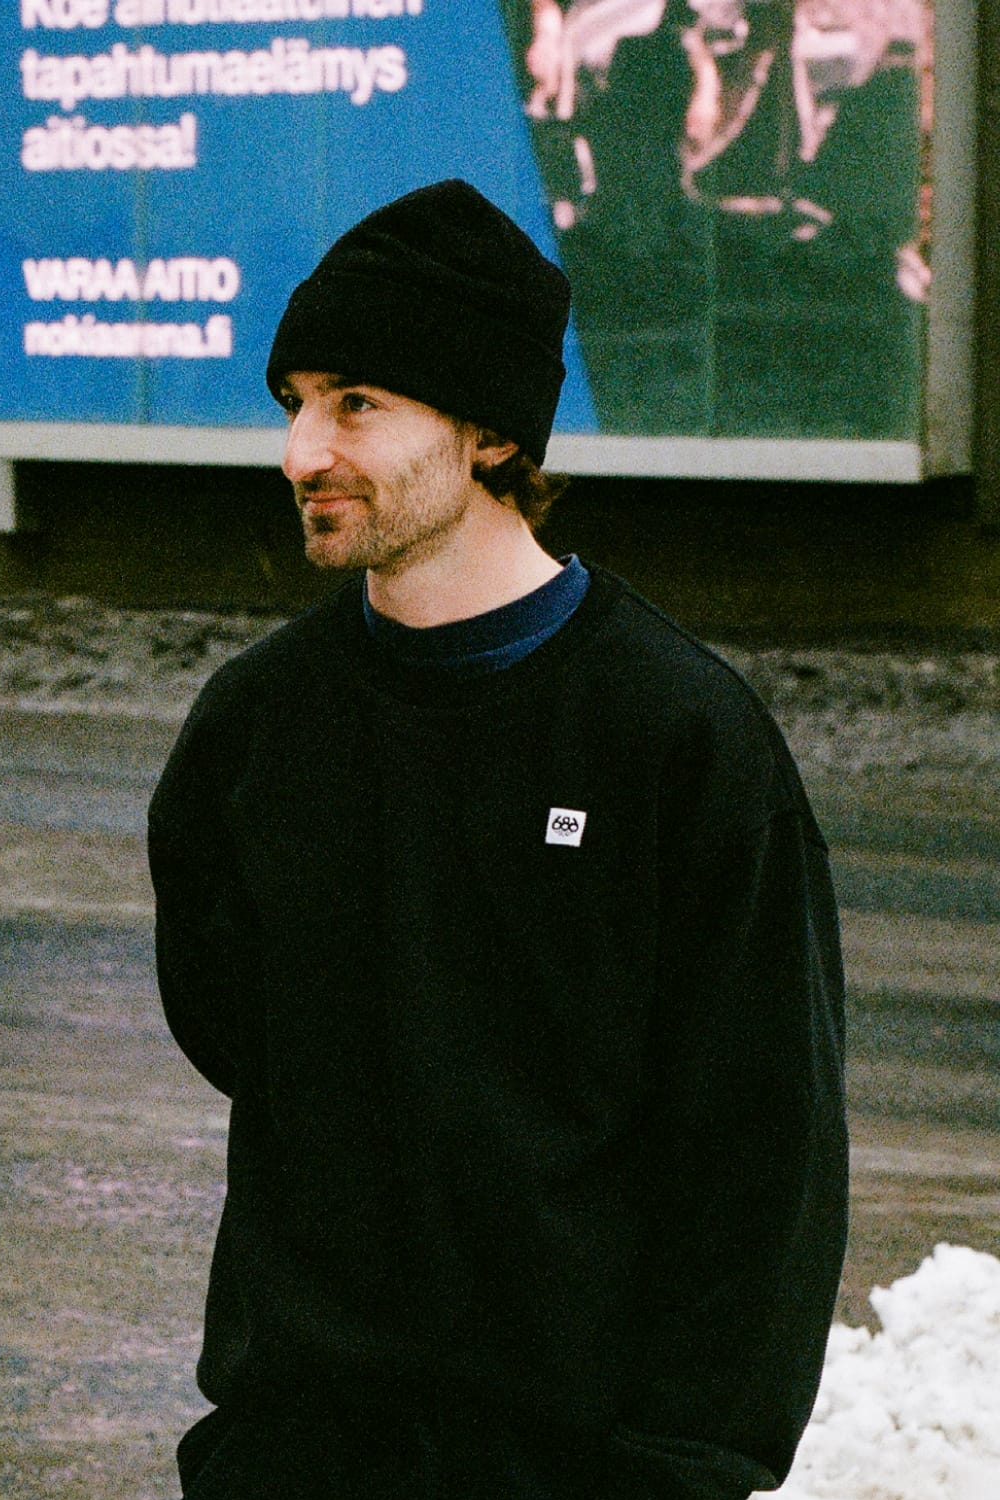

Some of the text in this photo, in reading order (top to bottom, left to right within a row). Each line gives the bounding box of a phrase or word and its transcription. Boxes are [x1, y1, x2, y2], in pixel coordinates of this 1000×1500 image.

[22, 38, 406, 108] tapahtumaelämys
[22, 113, 196, 170] aitiossa!
[23, 257, 240, 301] VARAA AITIO
